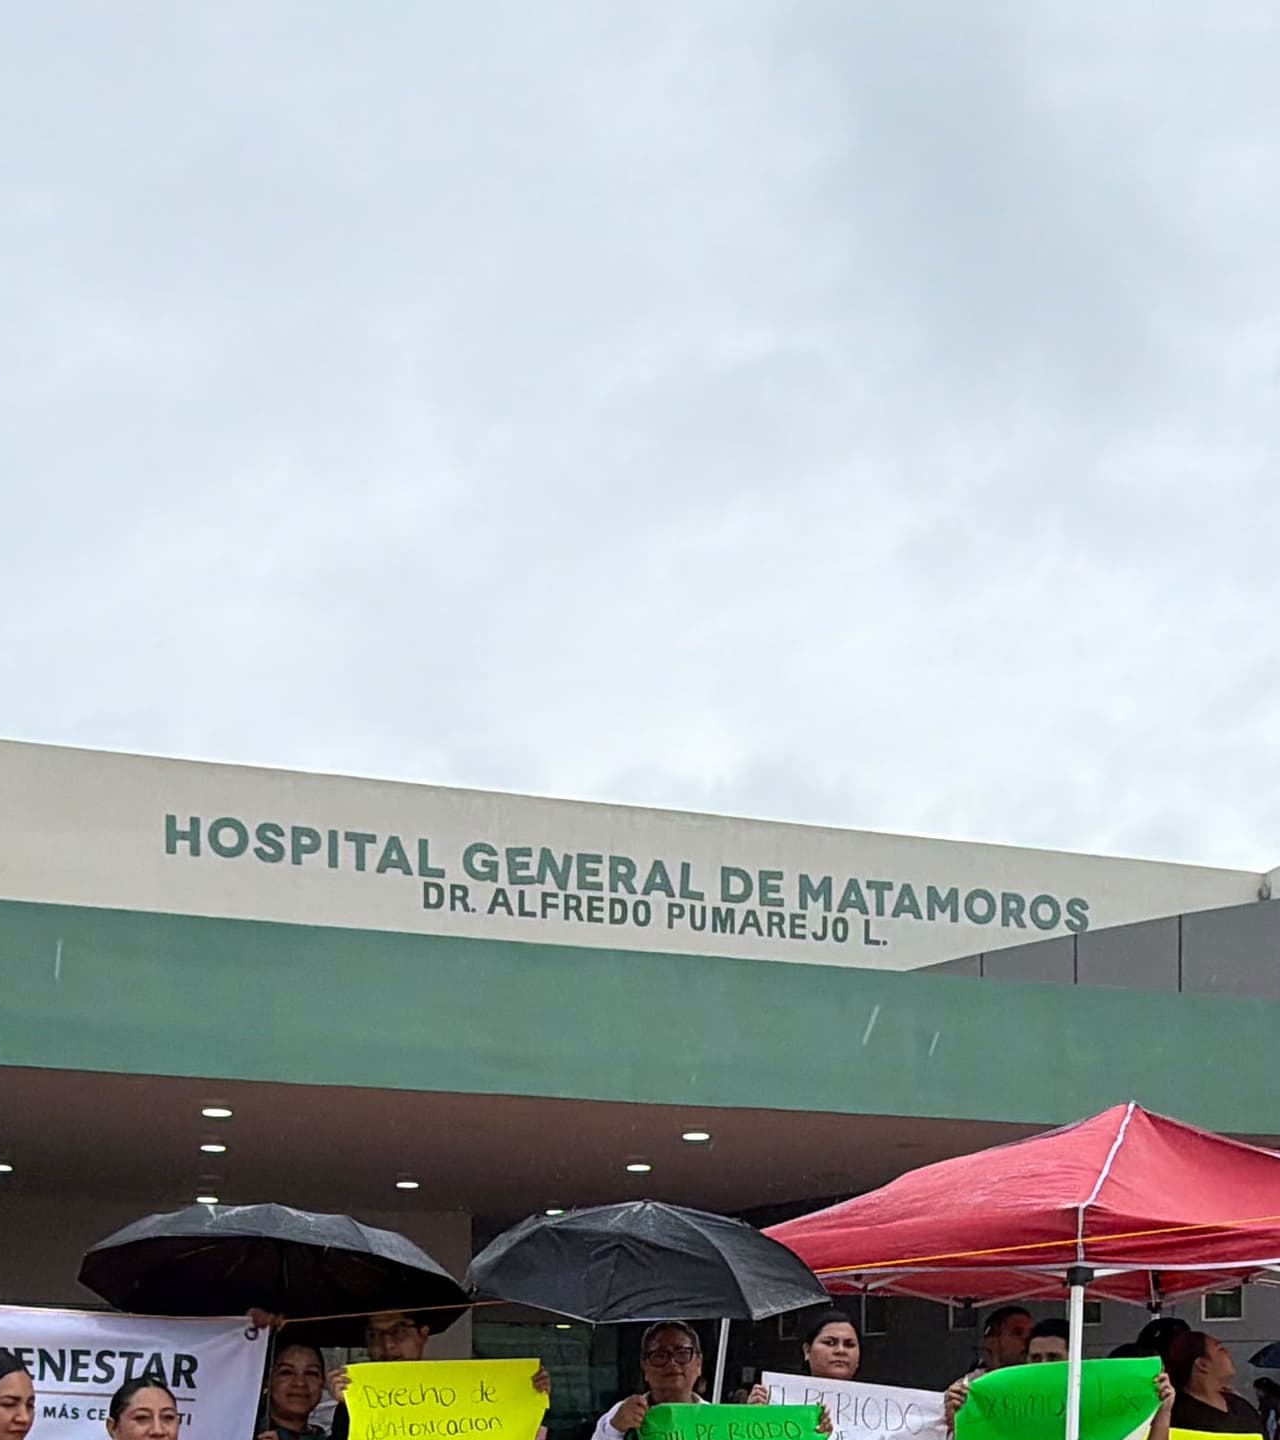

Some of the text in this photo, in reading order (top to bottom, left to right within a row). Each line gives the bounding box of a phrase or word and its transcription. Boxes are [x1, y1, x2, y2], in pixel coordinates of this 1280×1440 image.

[165, 813, 1090, 933] HOSPITAL GENERAL DE MATAMOROS
[422, 881, 889, 947] DR. ALFREDO PUMAREJO L.
[43, 1402, 80, 1421] MÁS
[363, 1380, 497, 1409] Derecho de
